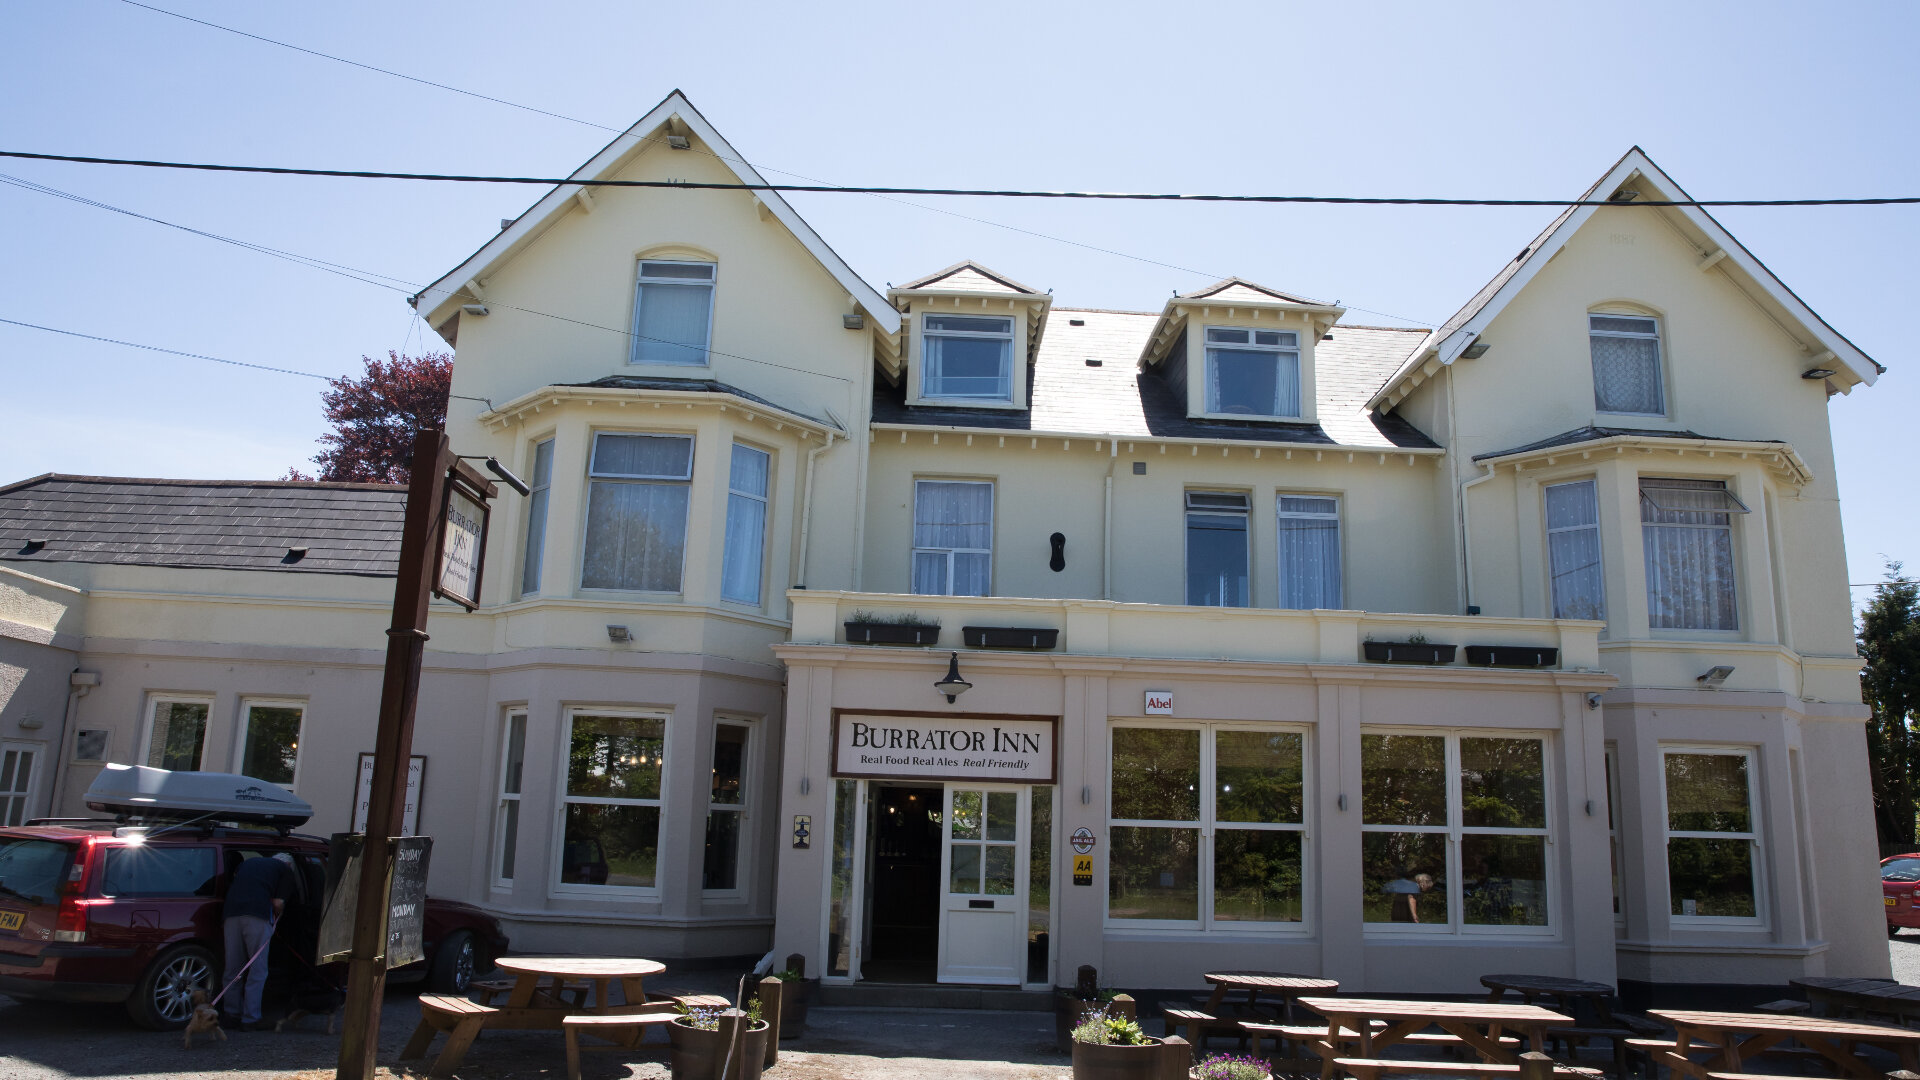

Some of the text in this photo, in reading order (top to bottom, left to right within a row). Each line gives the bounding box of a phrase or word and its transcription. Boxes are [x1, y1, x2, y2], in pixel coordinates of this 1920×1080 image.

[448, 504, 481, 538] BURRATOR
[1147, 697, 1172, 709] Abel
[851, 722, 1041, 754] BURRATOR INN
[861, 754, 1030, 771] Real Food Real Ales Real Friendly
[398, 848, 423, 863] SUNDAY
[1076, 860, 1091, 872] AA
[391, 903, 416, 918] MONDAY
